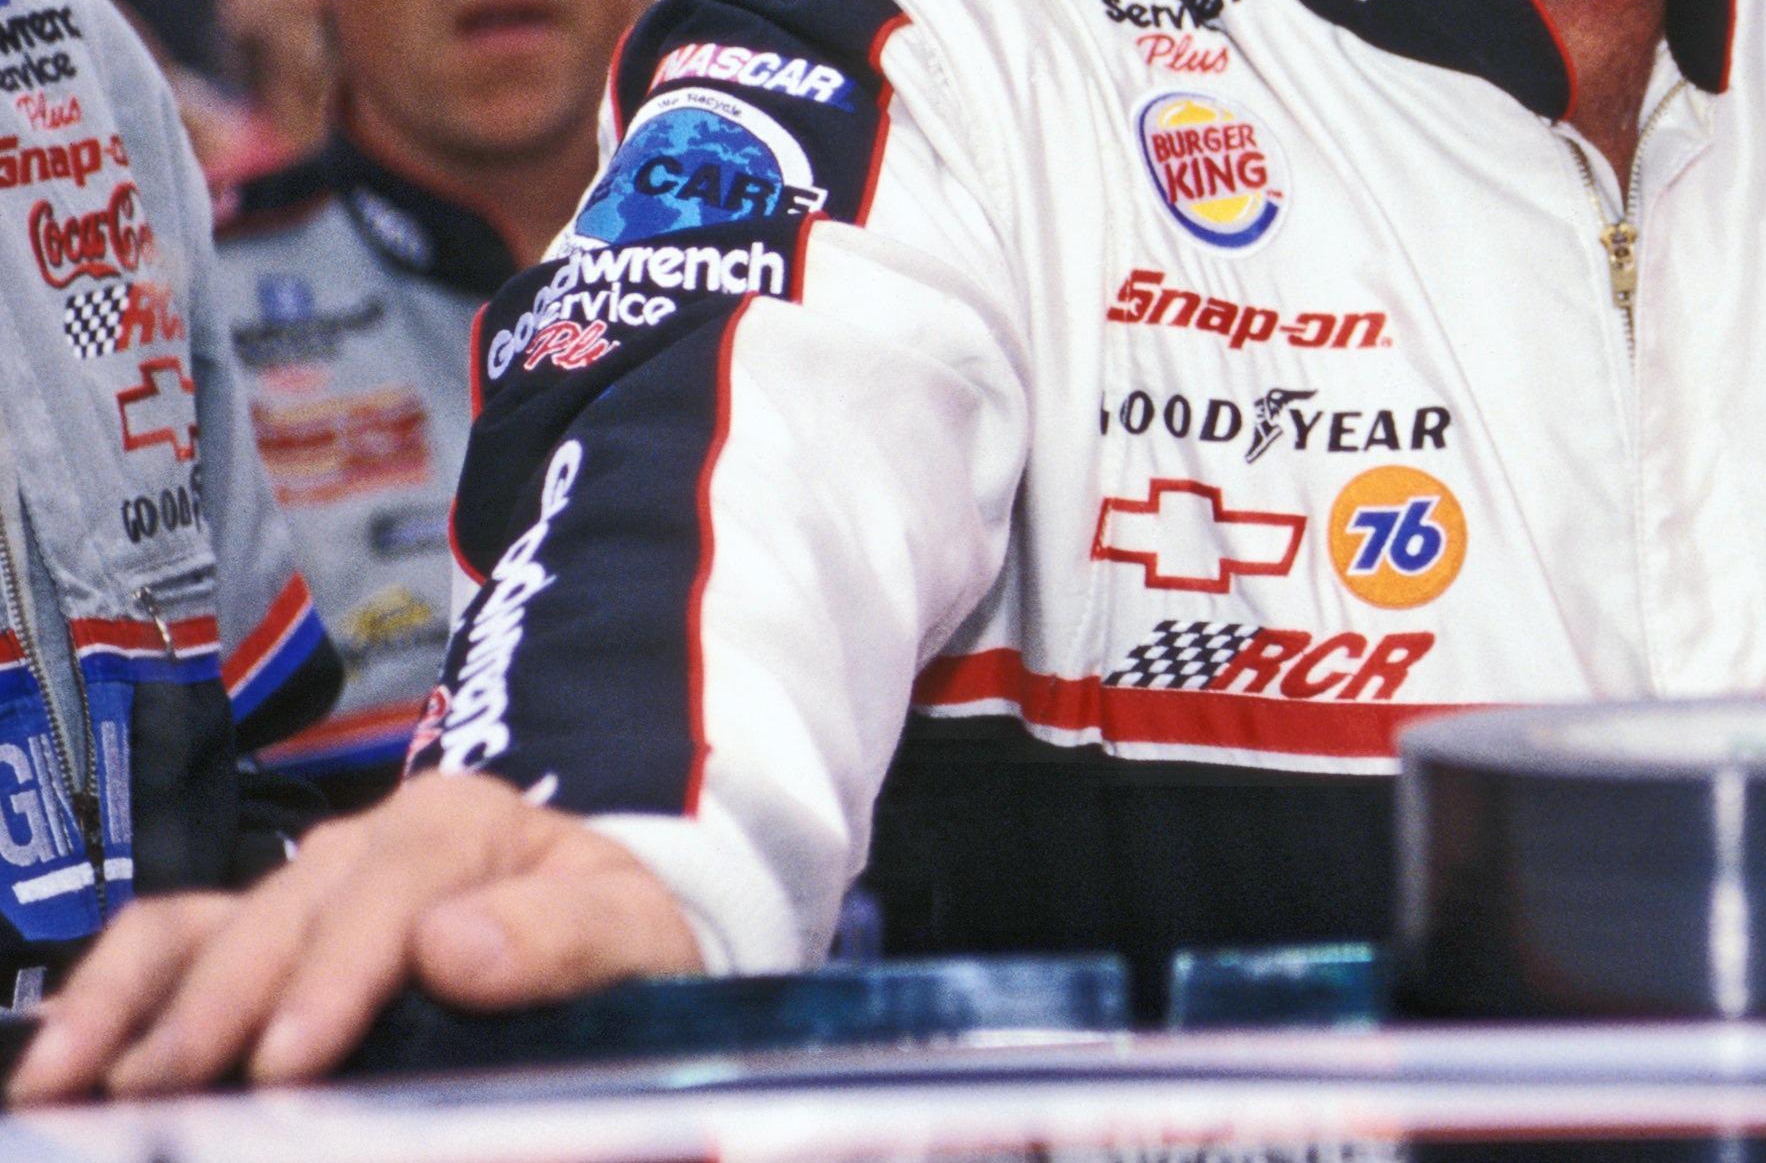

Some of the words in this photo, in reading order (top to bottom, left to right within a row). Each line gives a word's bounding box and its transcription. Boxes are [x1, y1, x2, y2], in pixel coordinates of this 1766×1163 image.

[656, 43, 846, 103] NASCAR
[1135, 33, 1229, 74] Plus
[0, 133, 130, 187] Snap-o
[1152, 123, 1257, 163] BURGER
[1164, 151, 1268, 205] KING
[1106, 268, 1388, 349] Snap-on
[1347, 496, 1444, 575] 76
[1207, 627, 1436, 701] RCR
